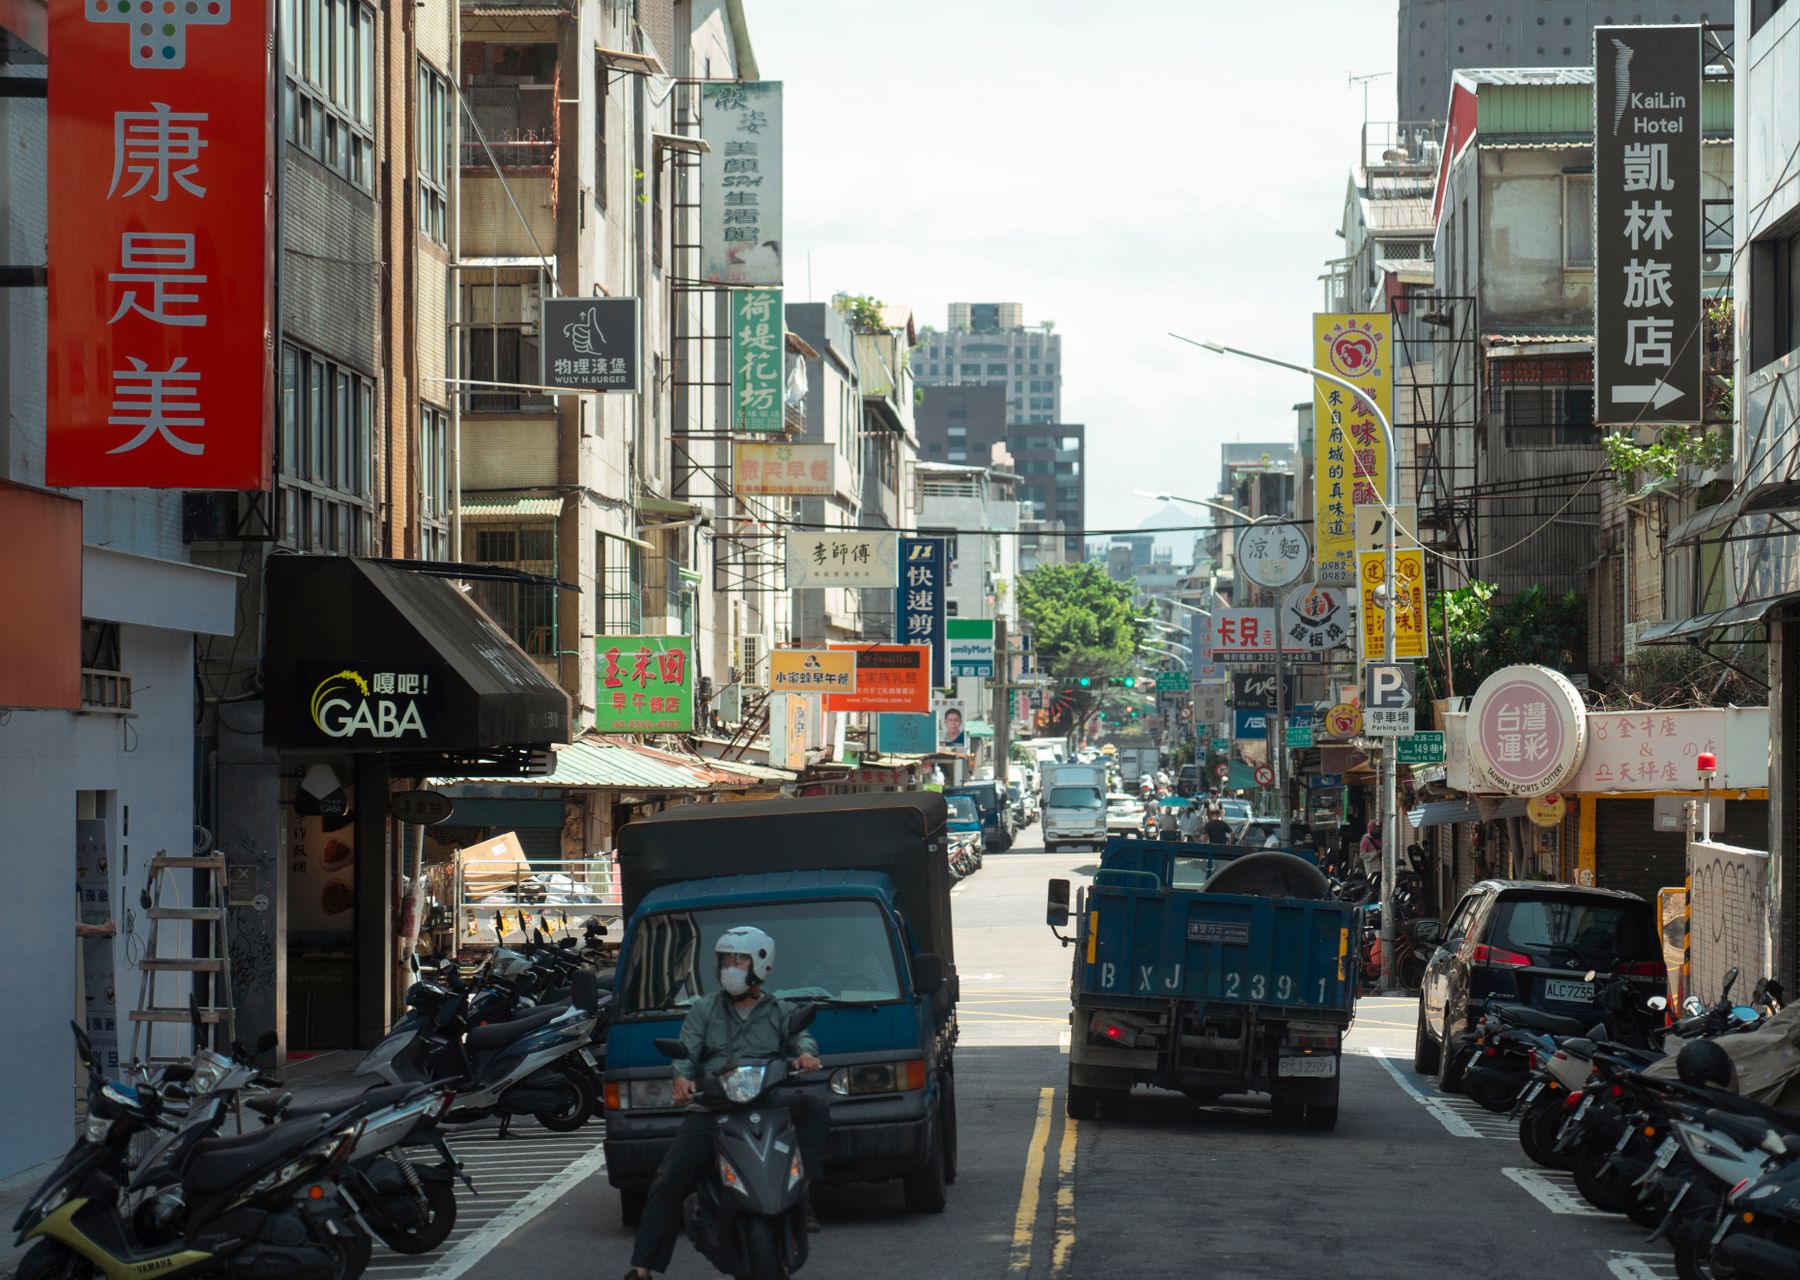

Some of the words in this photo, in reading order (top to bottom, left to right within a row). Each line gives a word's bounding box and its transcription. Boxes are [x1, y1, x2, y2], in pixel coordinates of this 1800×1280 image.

[1631, 92, 1686, 109] KaiLin
[1634, 116, 1683, 134] Hotel
[1623, 142, 1675, 367] 凱林旅店
[105, 102, 208, 455] 康是美
[738, 292, 778, 410] 荷堤花坊
[554, 357, 627, 375] 物理漢堡
[555, 375, 579, 384] WULY
[582, 375, 626, 384] H.BURGER
[1328, 390, 1346, 536] 來自府城的真味道
[812, 541, 871, 566] 李師傅
[1248, 536, 1300, 560] 涼麵
[1289, 622, 1344, 648] 鐵板燒
[951, 644, 993, 656] amilyMart
[1373, 666, 1403, 705] P
[612, 692, 680, 714] 早午餐店
[318, 698, 428, 739] GABA
[1372, 711, 1409, 724] 停車場
[1372, 724, 1397, 732] Parking
[1497, 702, 1547, 732] 台灣
[1616, 716, 1678, 738] 金牛座
[1414, 743, 1428, 754] 149
[1497, 731, 1549, 762] 運彩
[1487, 767, 1510, 789] TAIWAN
[1512, 783, 1539, 793] SPORTS
[1541, 763, 1564, 788] LOTTERY
[1619, 761, 1679, 782] 天秤座
[1226, 972, 1326, 1004] 2391
[136, 1258, 173, 1273] YAMAHA
